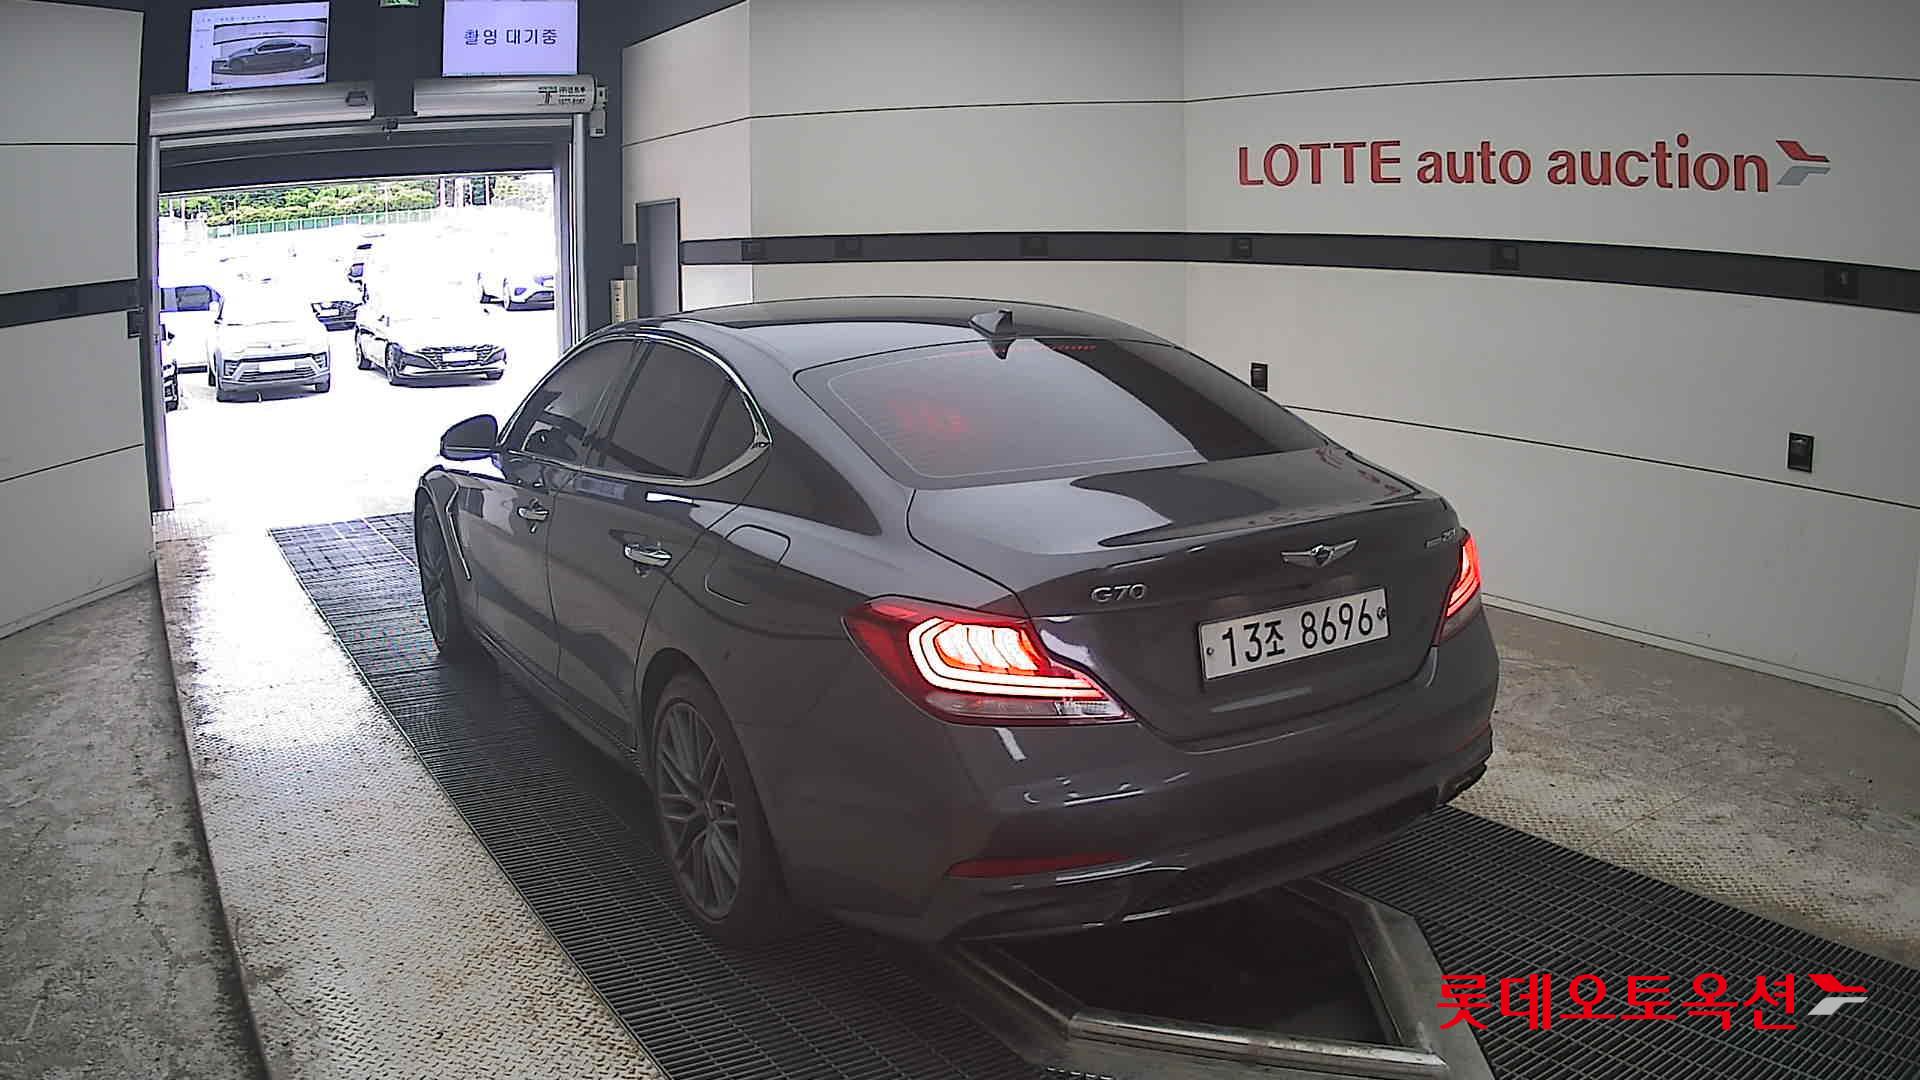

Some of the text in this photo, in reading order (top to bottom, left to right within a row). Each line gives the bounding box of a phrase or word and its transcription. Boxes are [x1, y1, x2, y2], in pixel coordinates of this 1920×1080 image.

[506, 29, 558, 45] 대기중
[1238, 133, 1769, 193] LOTTE auto auction
[1091, 584, 1145, 602] G70
[1222, 598, 1373, 667] 13조 8696
